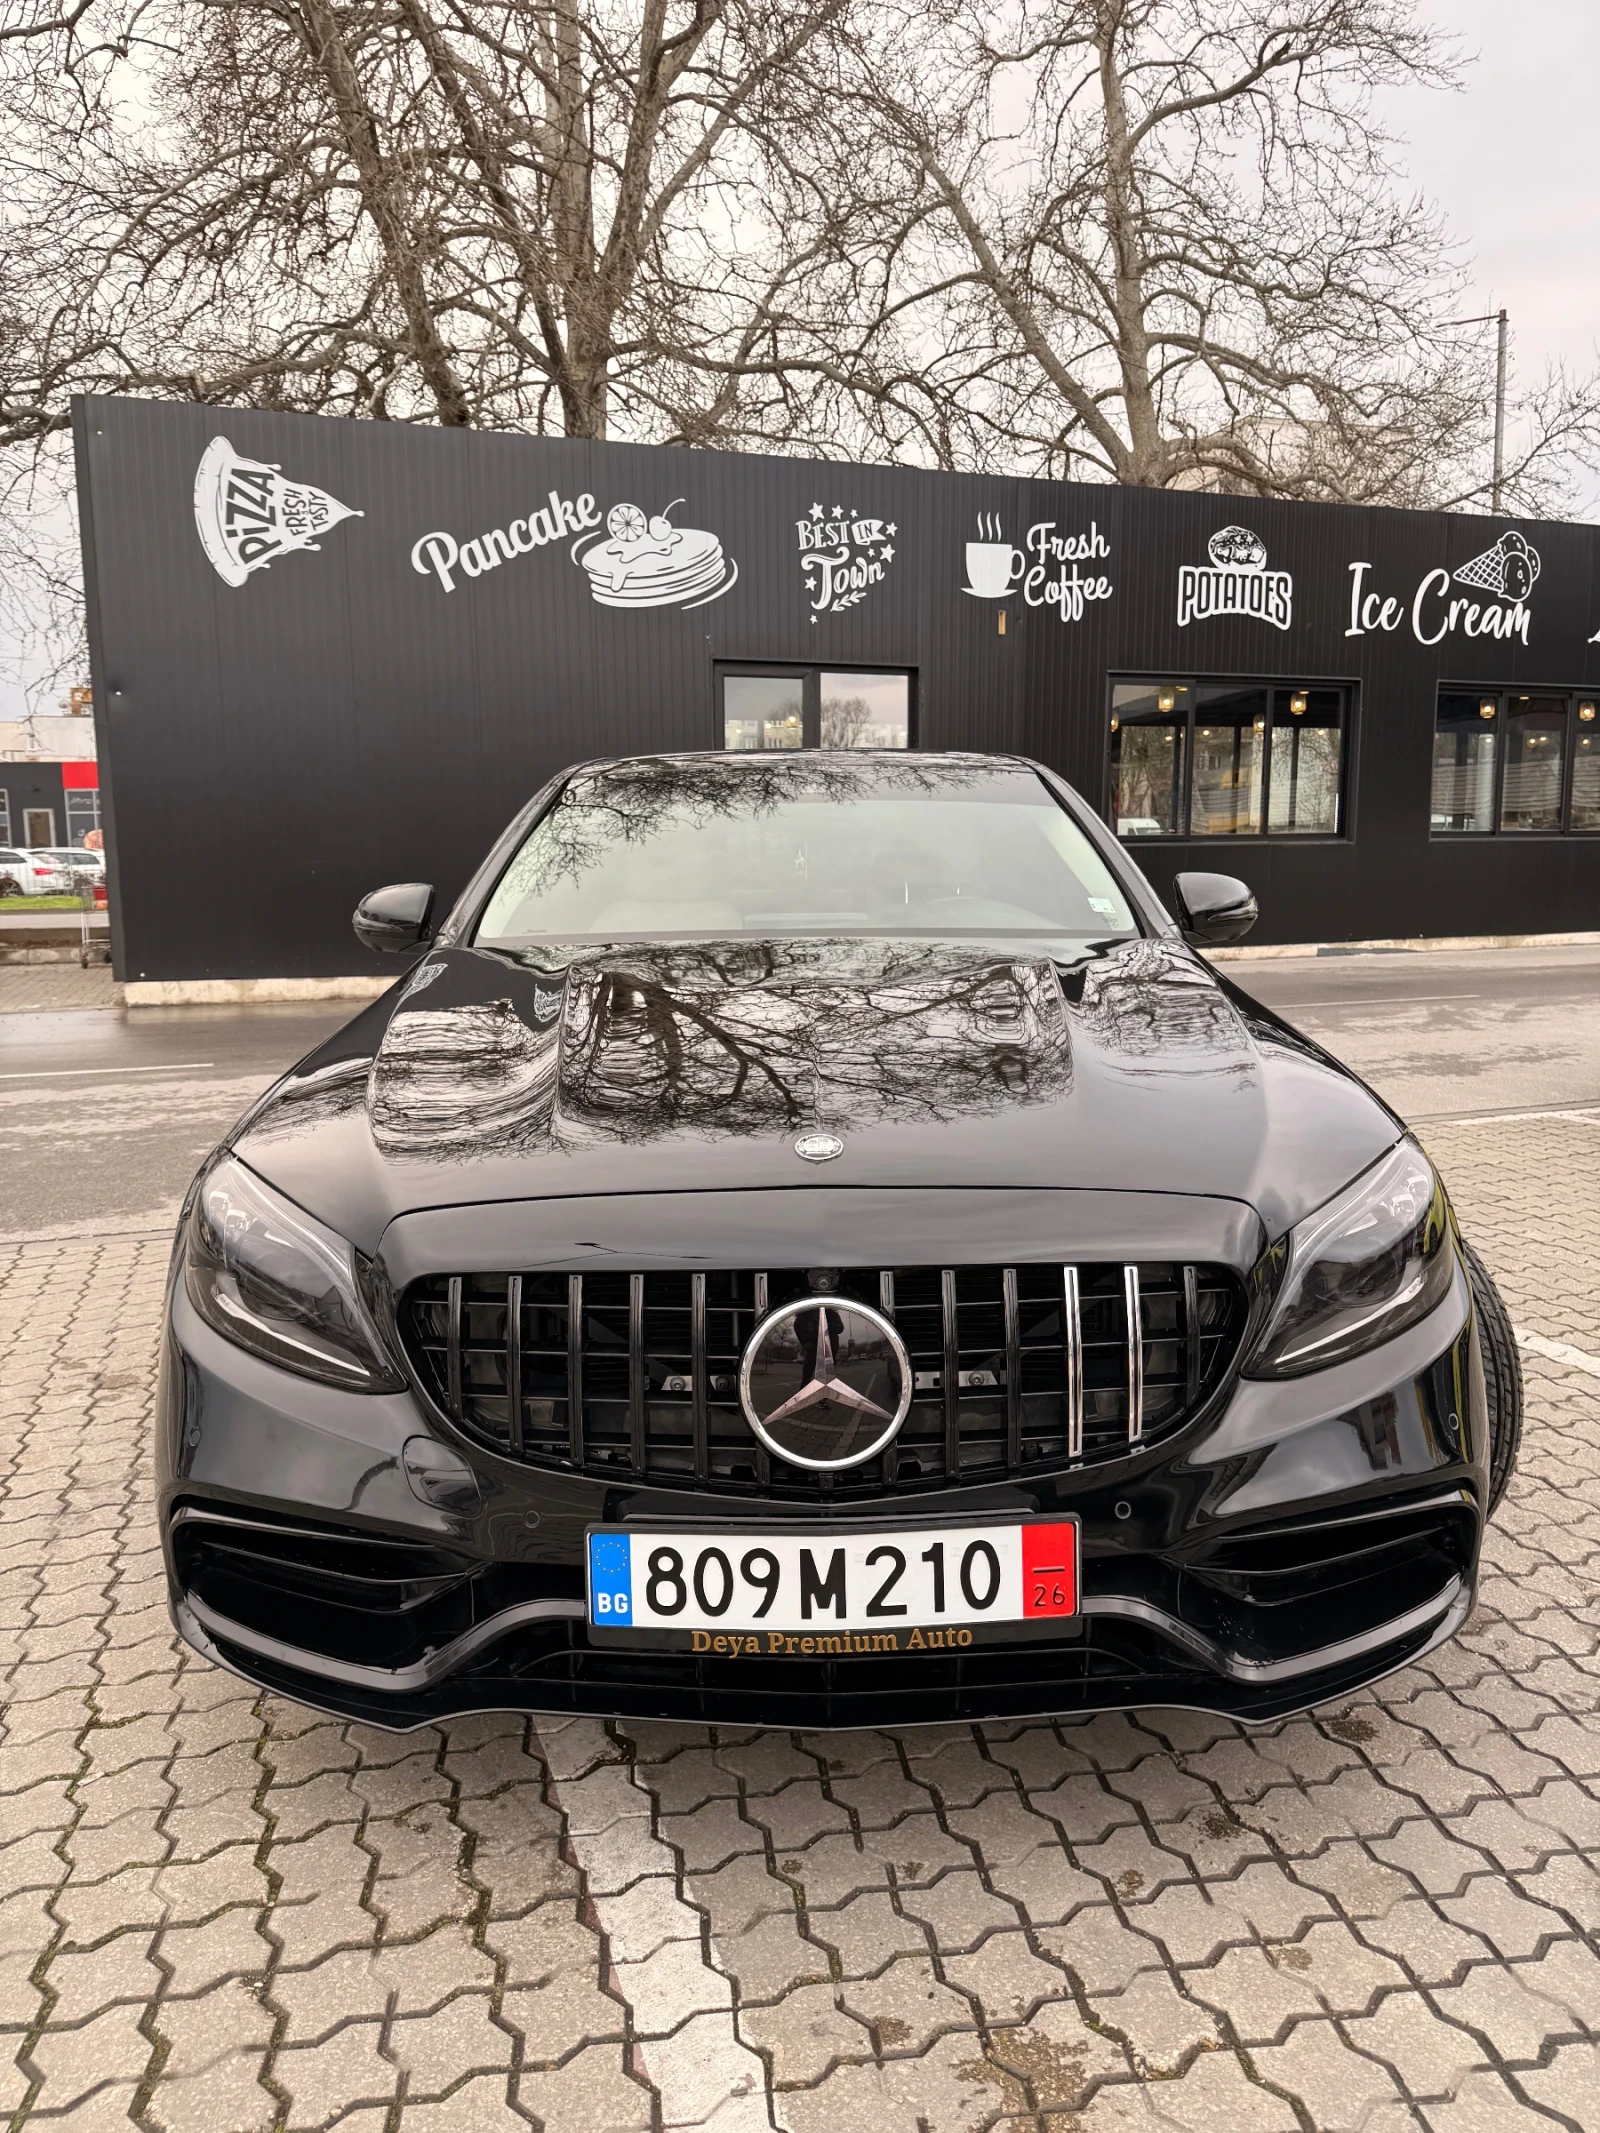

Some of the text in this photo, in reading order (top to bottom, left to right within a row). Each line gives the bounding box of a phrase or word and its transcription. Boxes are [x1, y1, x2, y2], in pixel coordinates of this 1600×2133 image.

[282, 488, 308, 536] FRESH
[309, 491, 329, 531] TASTY
[411, 490, 602, 593] Pancake
[795, 520, 873, 550] BEST IN
[1026, 521, 1111, 565] Fresh
[1023, 563, 1113, 623] Coffee
[1179, 567, 1291, 629] POTATOES
[1344, 561, 1531, 645] Ice Cream
[598, 1593, 628, 1614] BG
[1033, 1583, 1065, 1607] 26
[692, 1628, 973, 1660] Deya Premium Auto
